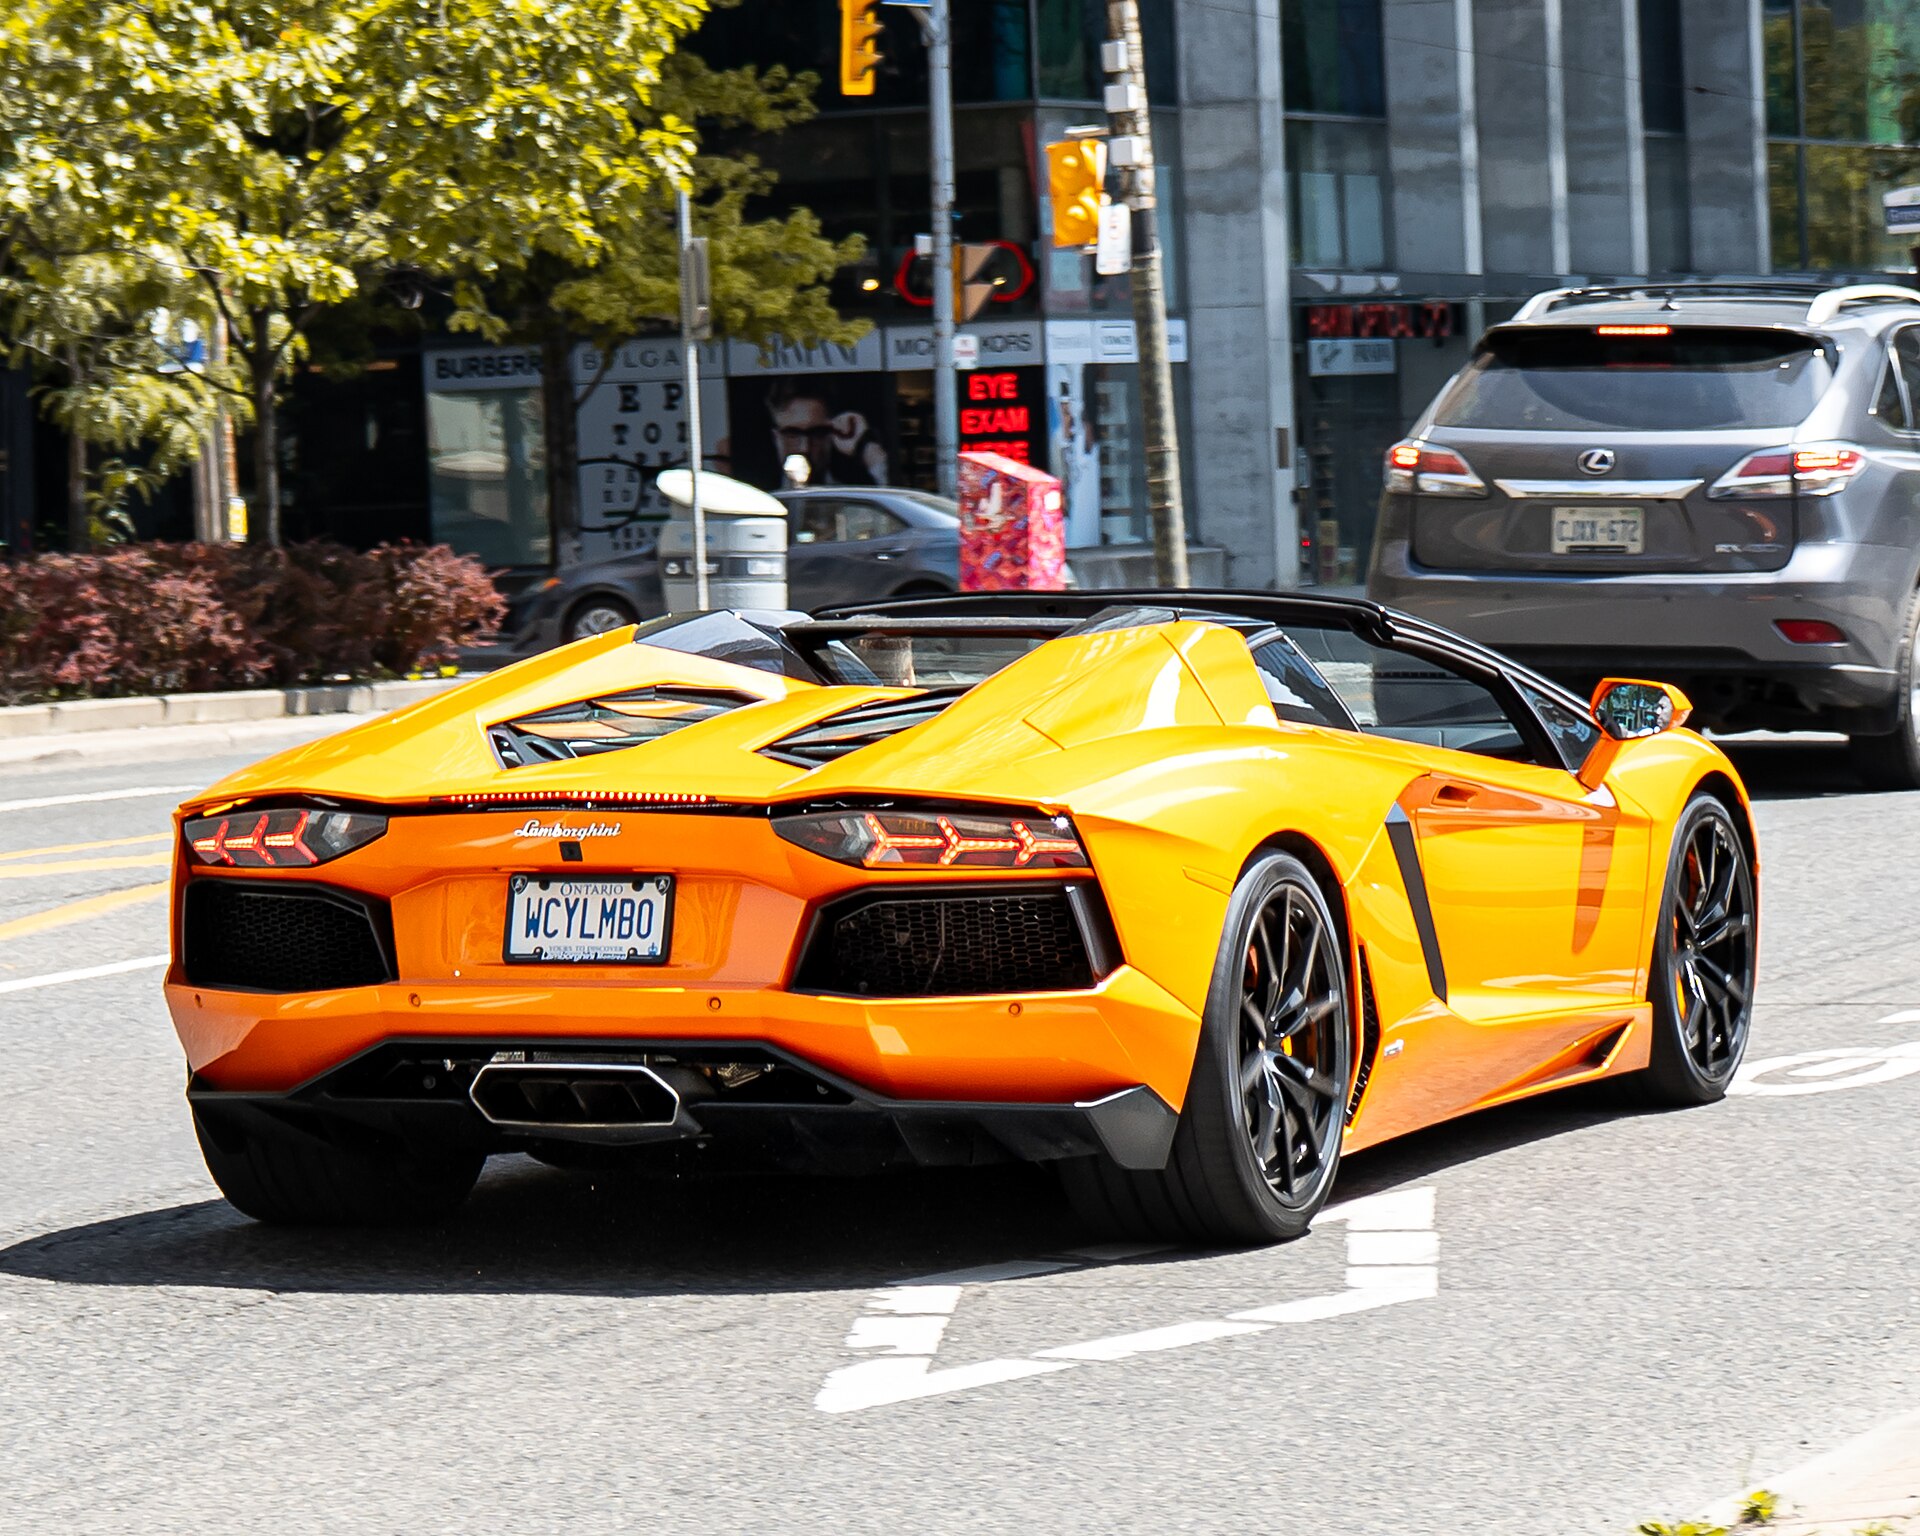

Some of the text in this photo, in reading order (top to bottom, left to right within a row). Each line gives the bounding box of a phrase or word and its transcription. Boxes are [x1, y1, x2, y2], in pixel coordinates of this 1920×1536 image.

[436, 354, 544, 379] BURBERR
[968, 373, 1017, 400] EYE
[961, 406, 1029, 434] EXAM
[514, 819, 622, 841] Lamborghini
